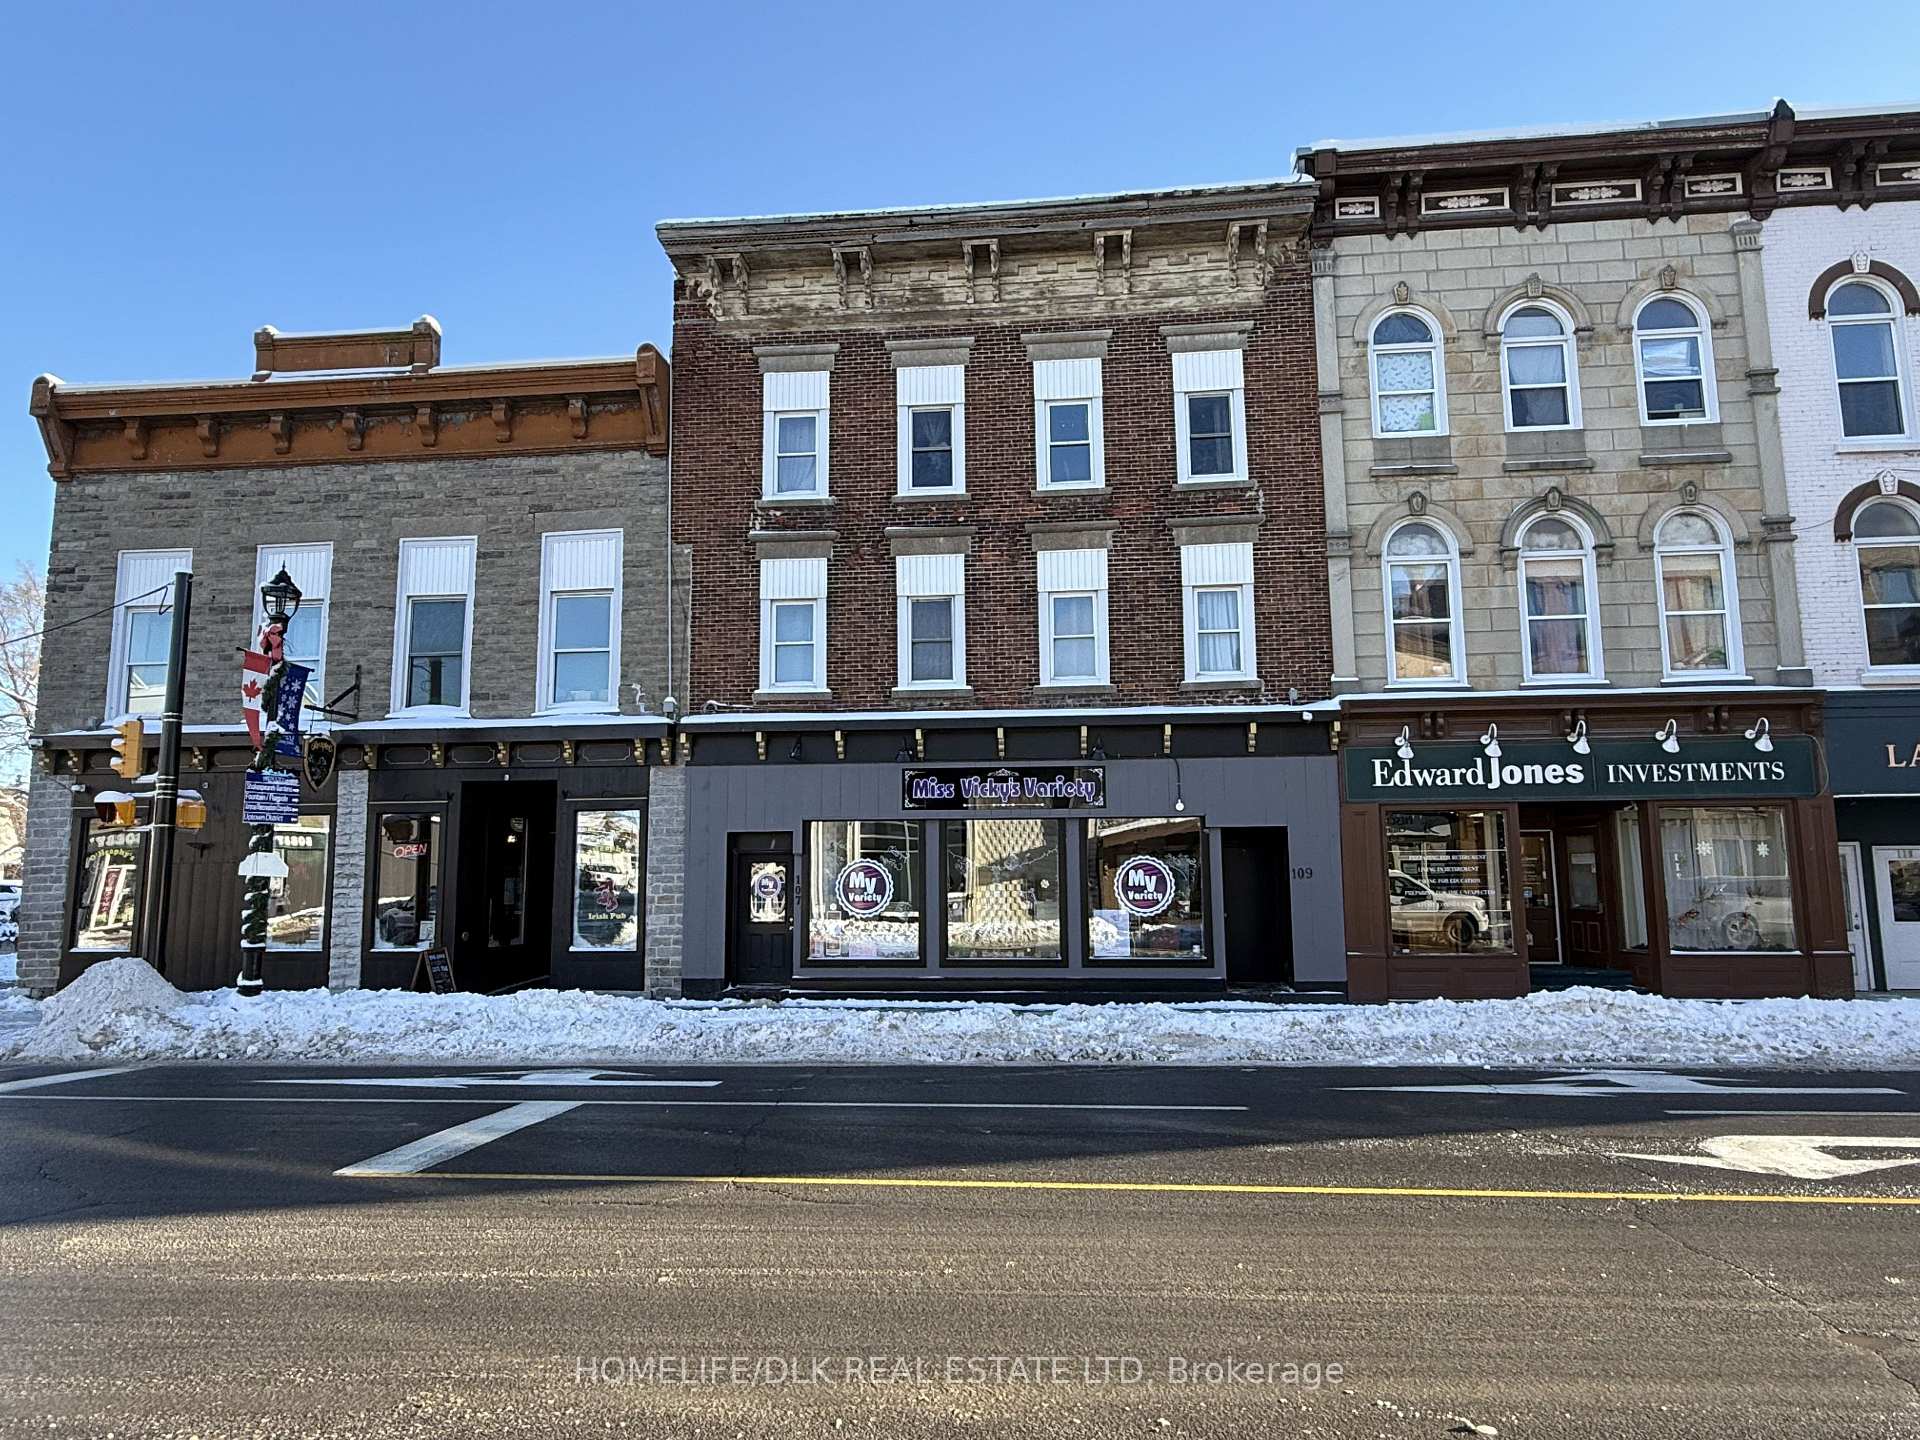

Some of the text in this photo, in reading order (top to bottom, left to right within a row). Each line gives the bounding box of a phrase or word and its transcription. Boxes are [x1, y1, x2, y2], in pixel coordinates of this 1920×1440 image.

[1371, 757, 1585, 790] Edward Jones
[1607, 761, 1785, 784] INVESTMENTS
[912, 775, 1096, 802] Miss Vicky's Variety
[393, 843, 428, 858] OPEN
[1291, 867, 1313, 880] 109
[848, 891, 882, 903] Variety
[1127, 890, 1163, 902] Variety
[588, 912, 627, 920] Irish Pub
